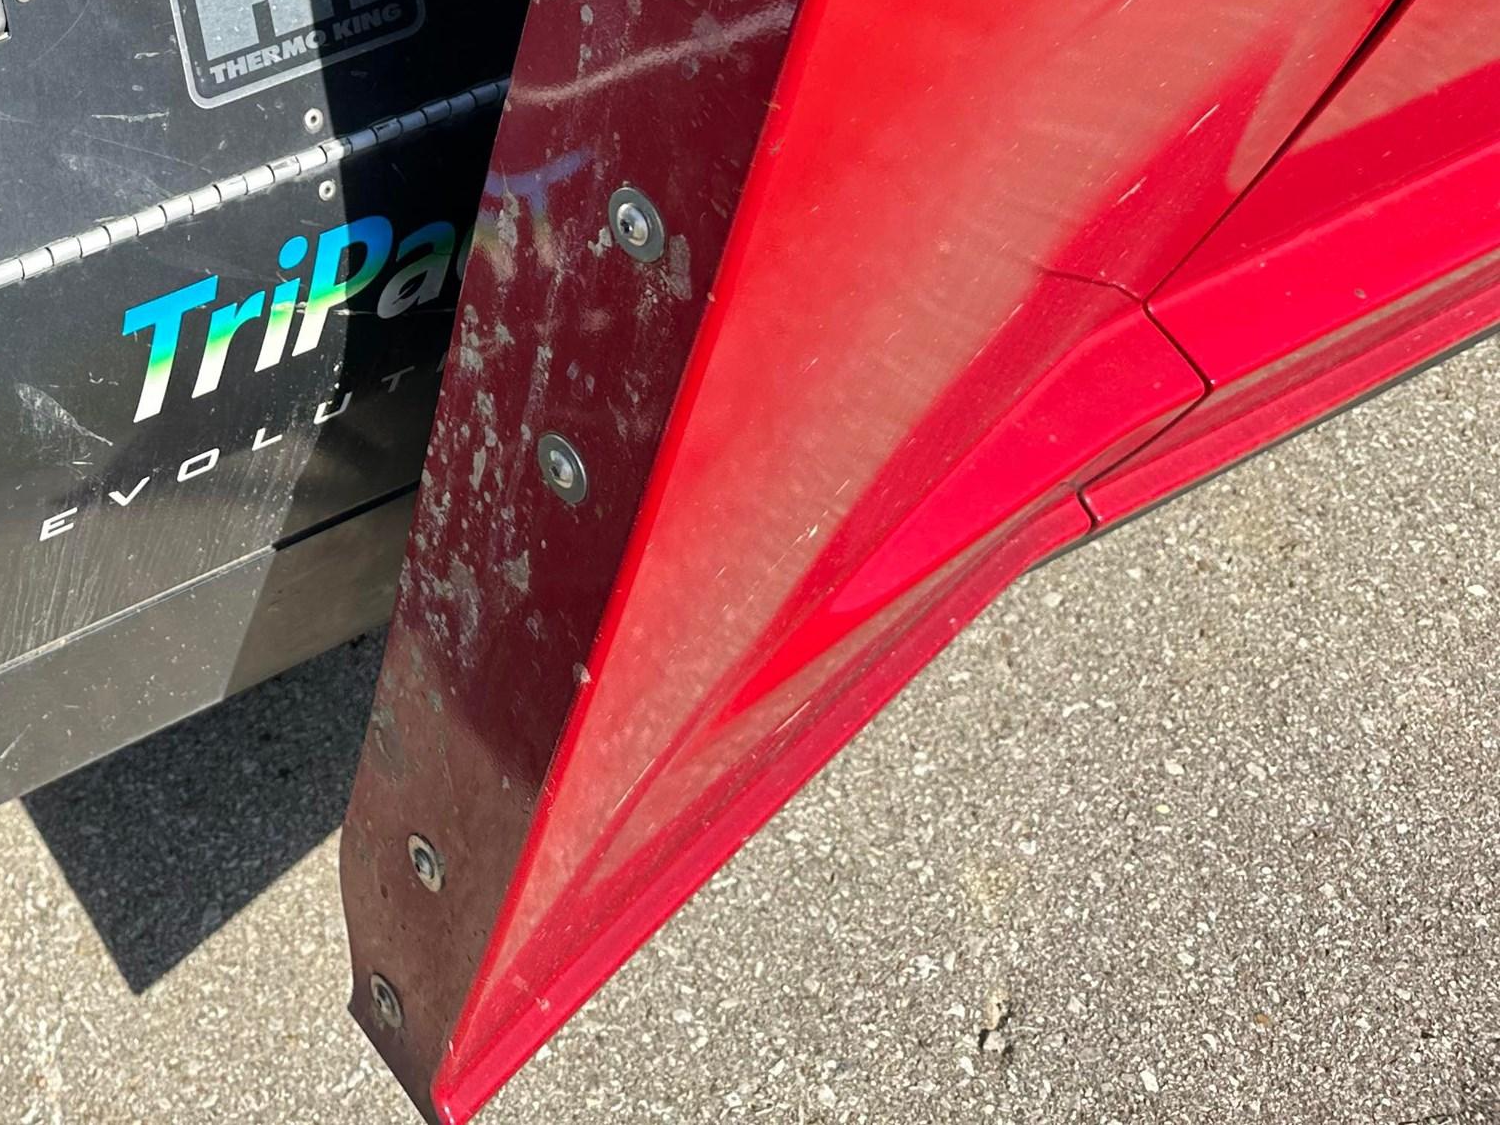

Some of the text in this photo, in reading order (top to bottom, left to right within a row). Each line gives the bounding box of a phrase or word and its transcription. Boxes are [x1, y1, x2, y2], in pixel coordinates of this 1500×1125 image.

[209, 2, 404, 84] THERMO KING
[121, 214, 474, 424] TriPa
